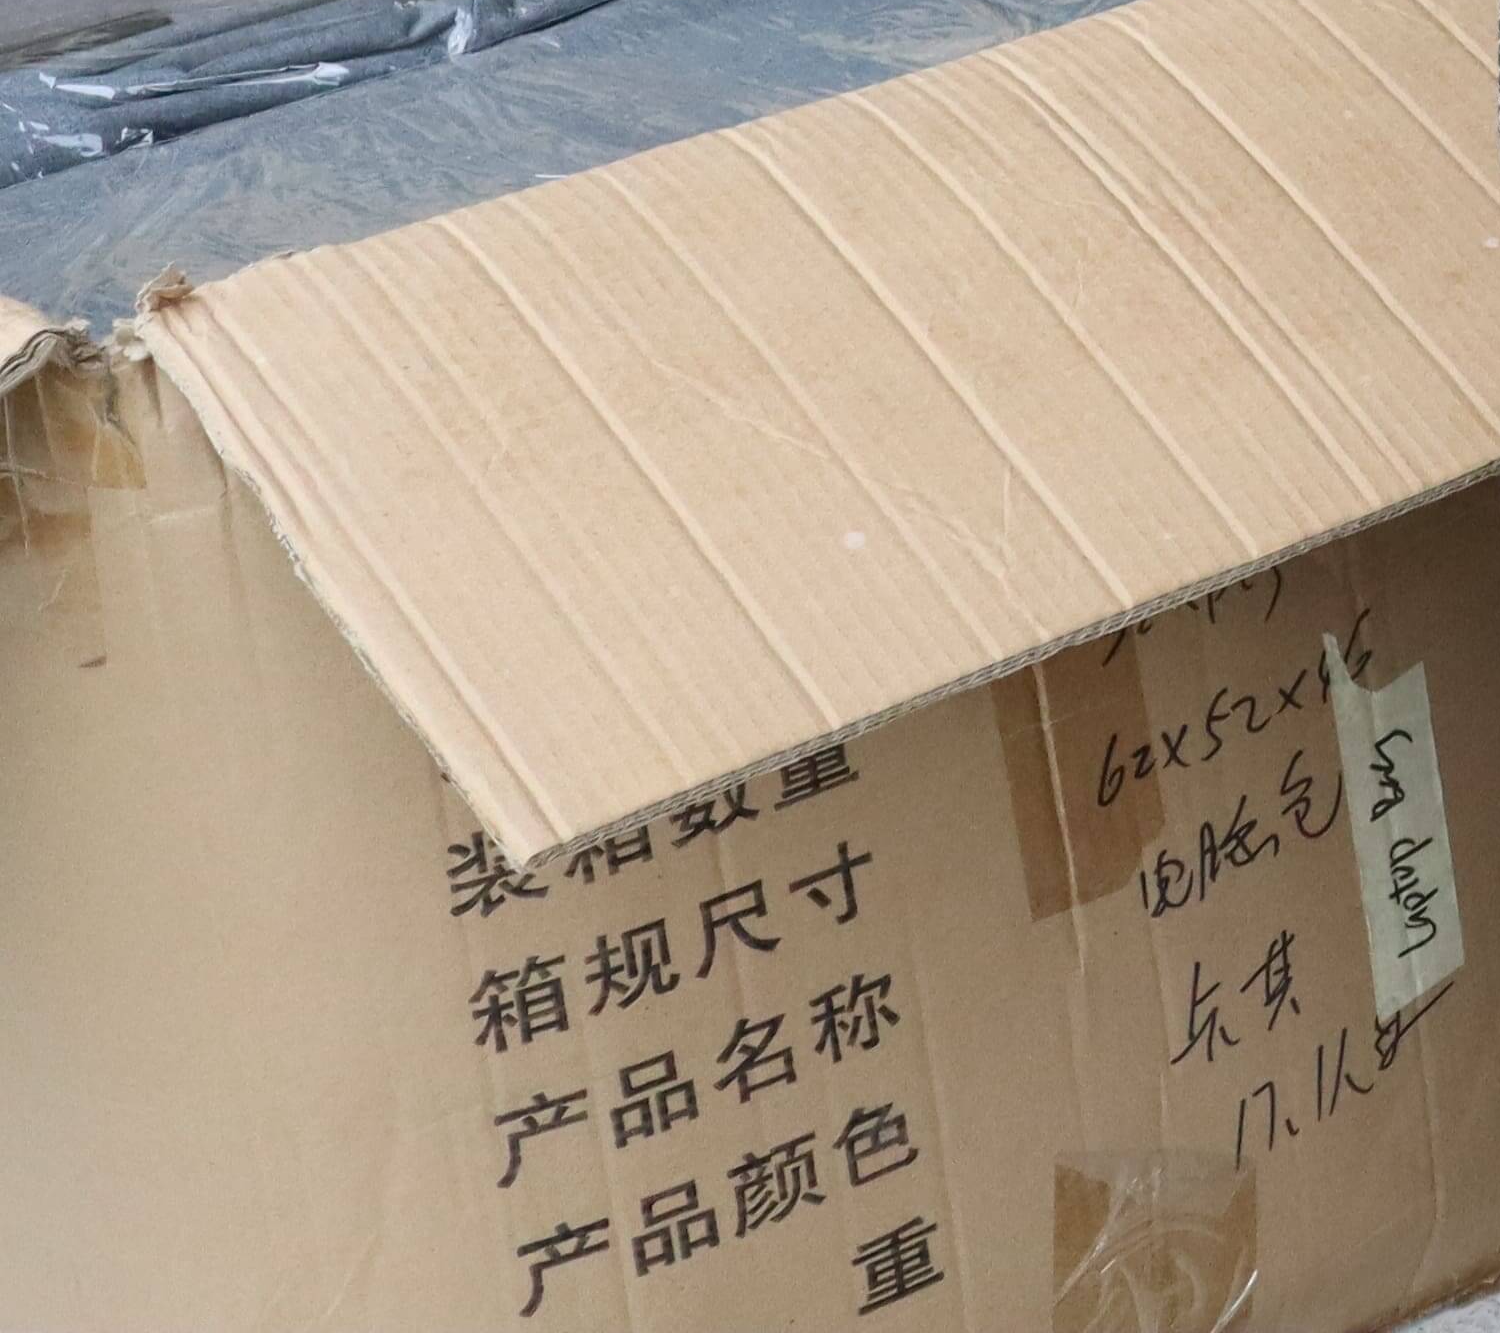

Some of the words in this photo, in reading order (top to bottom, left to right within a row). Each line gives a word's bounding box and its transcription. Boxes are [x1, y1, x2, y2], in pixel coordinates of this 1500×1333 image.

[468, 841, 873, 1053] 箱规尺寸
[494, 973, 900, 1189] 产品名称
[516, 1101, 918, 1317] 产品颜色
[852, 1216, 945, 1316] 重
